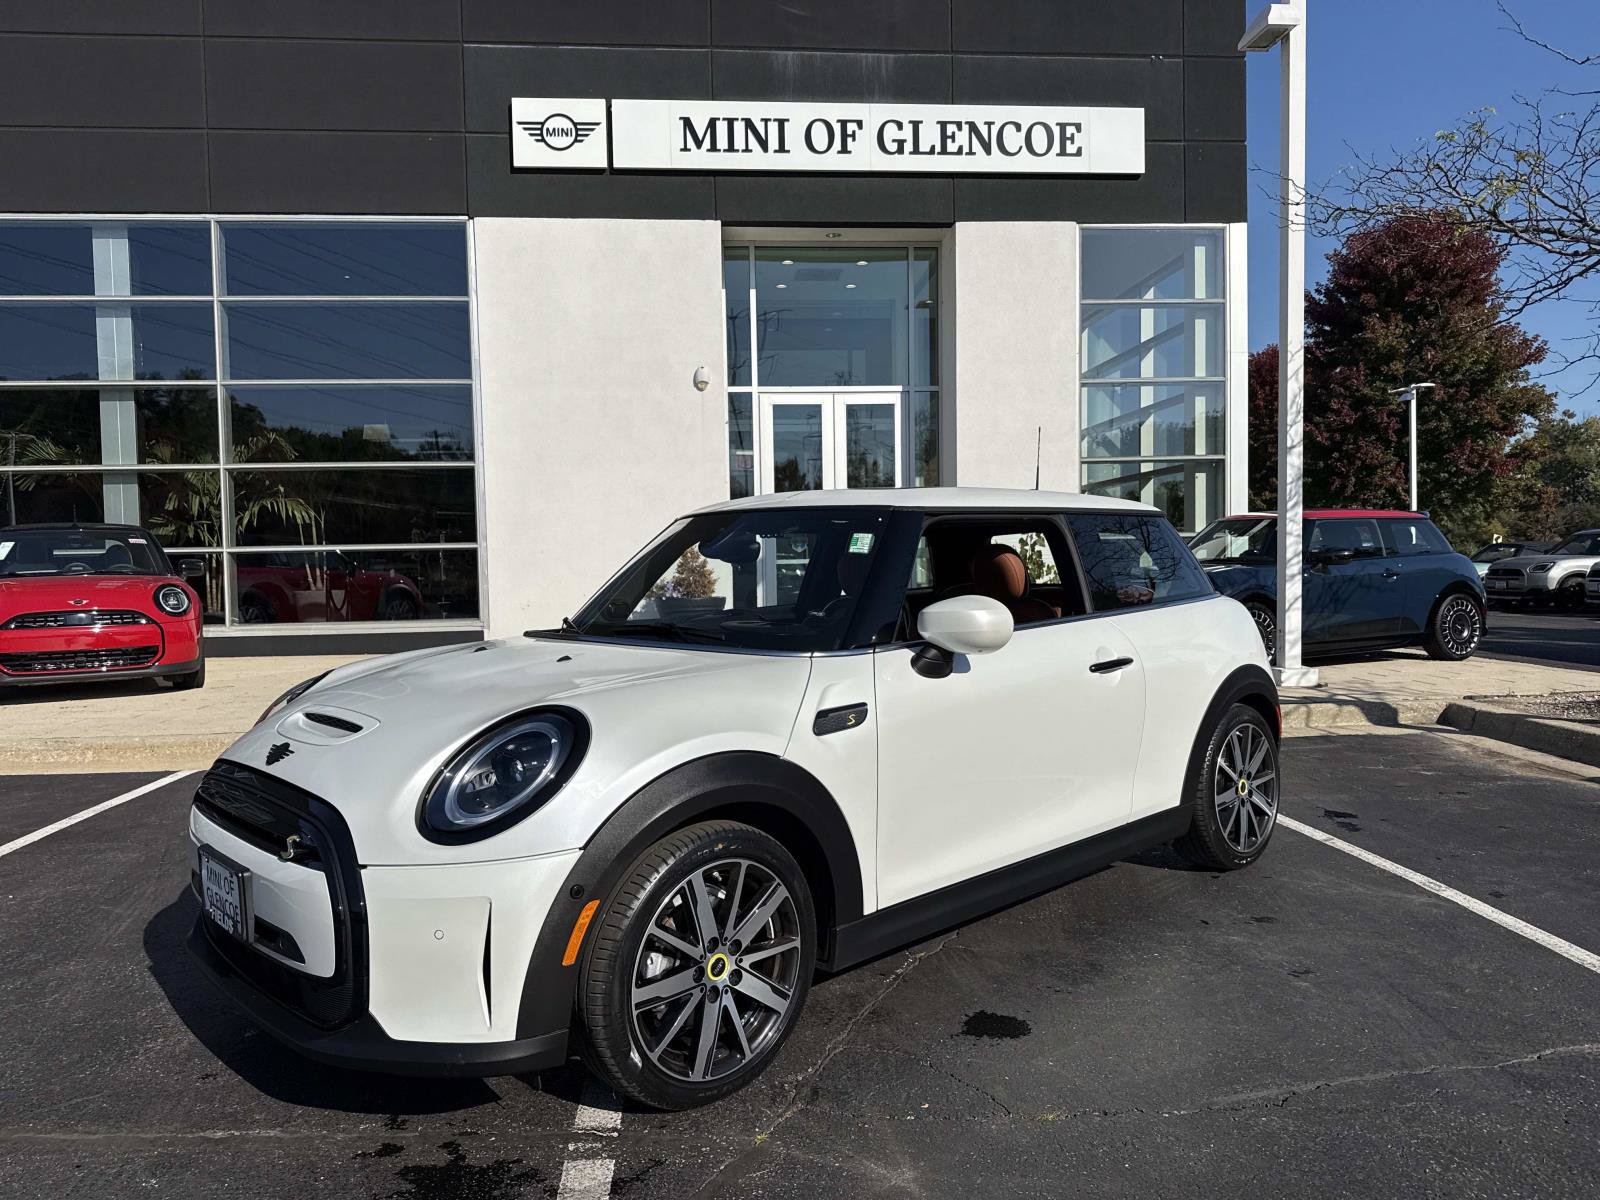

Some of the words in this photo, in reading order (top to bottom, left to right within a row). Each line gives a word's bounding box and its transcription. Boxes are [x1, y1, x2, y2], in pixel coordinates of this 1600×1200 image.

[545, 127, 573, 138] MINI
[678, 116, 791, 153] MINI
[804, 118, 864, 155] OF
[876, 119, 1083, 157] GLENCOE
[847, 713, 856, 725] S
[206, 864, 223, 891] MINI
[223, 877, 236, 898] OF
[206, 886, 241, 925] GLENCOE
